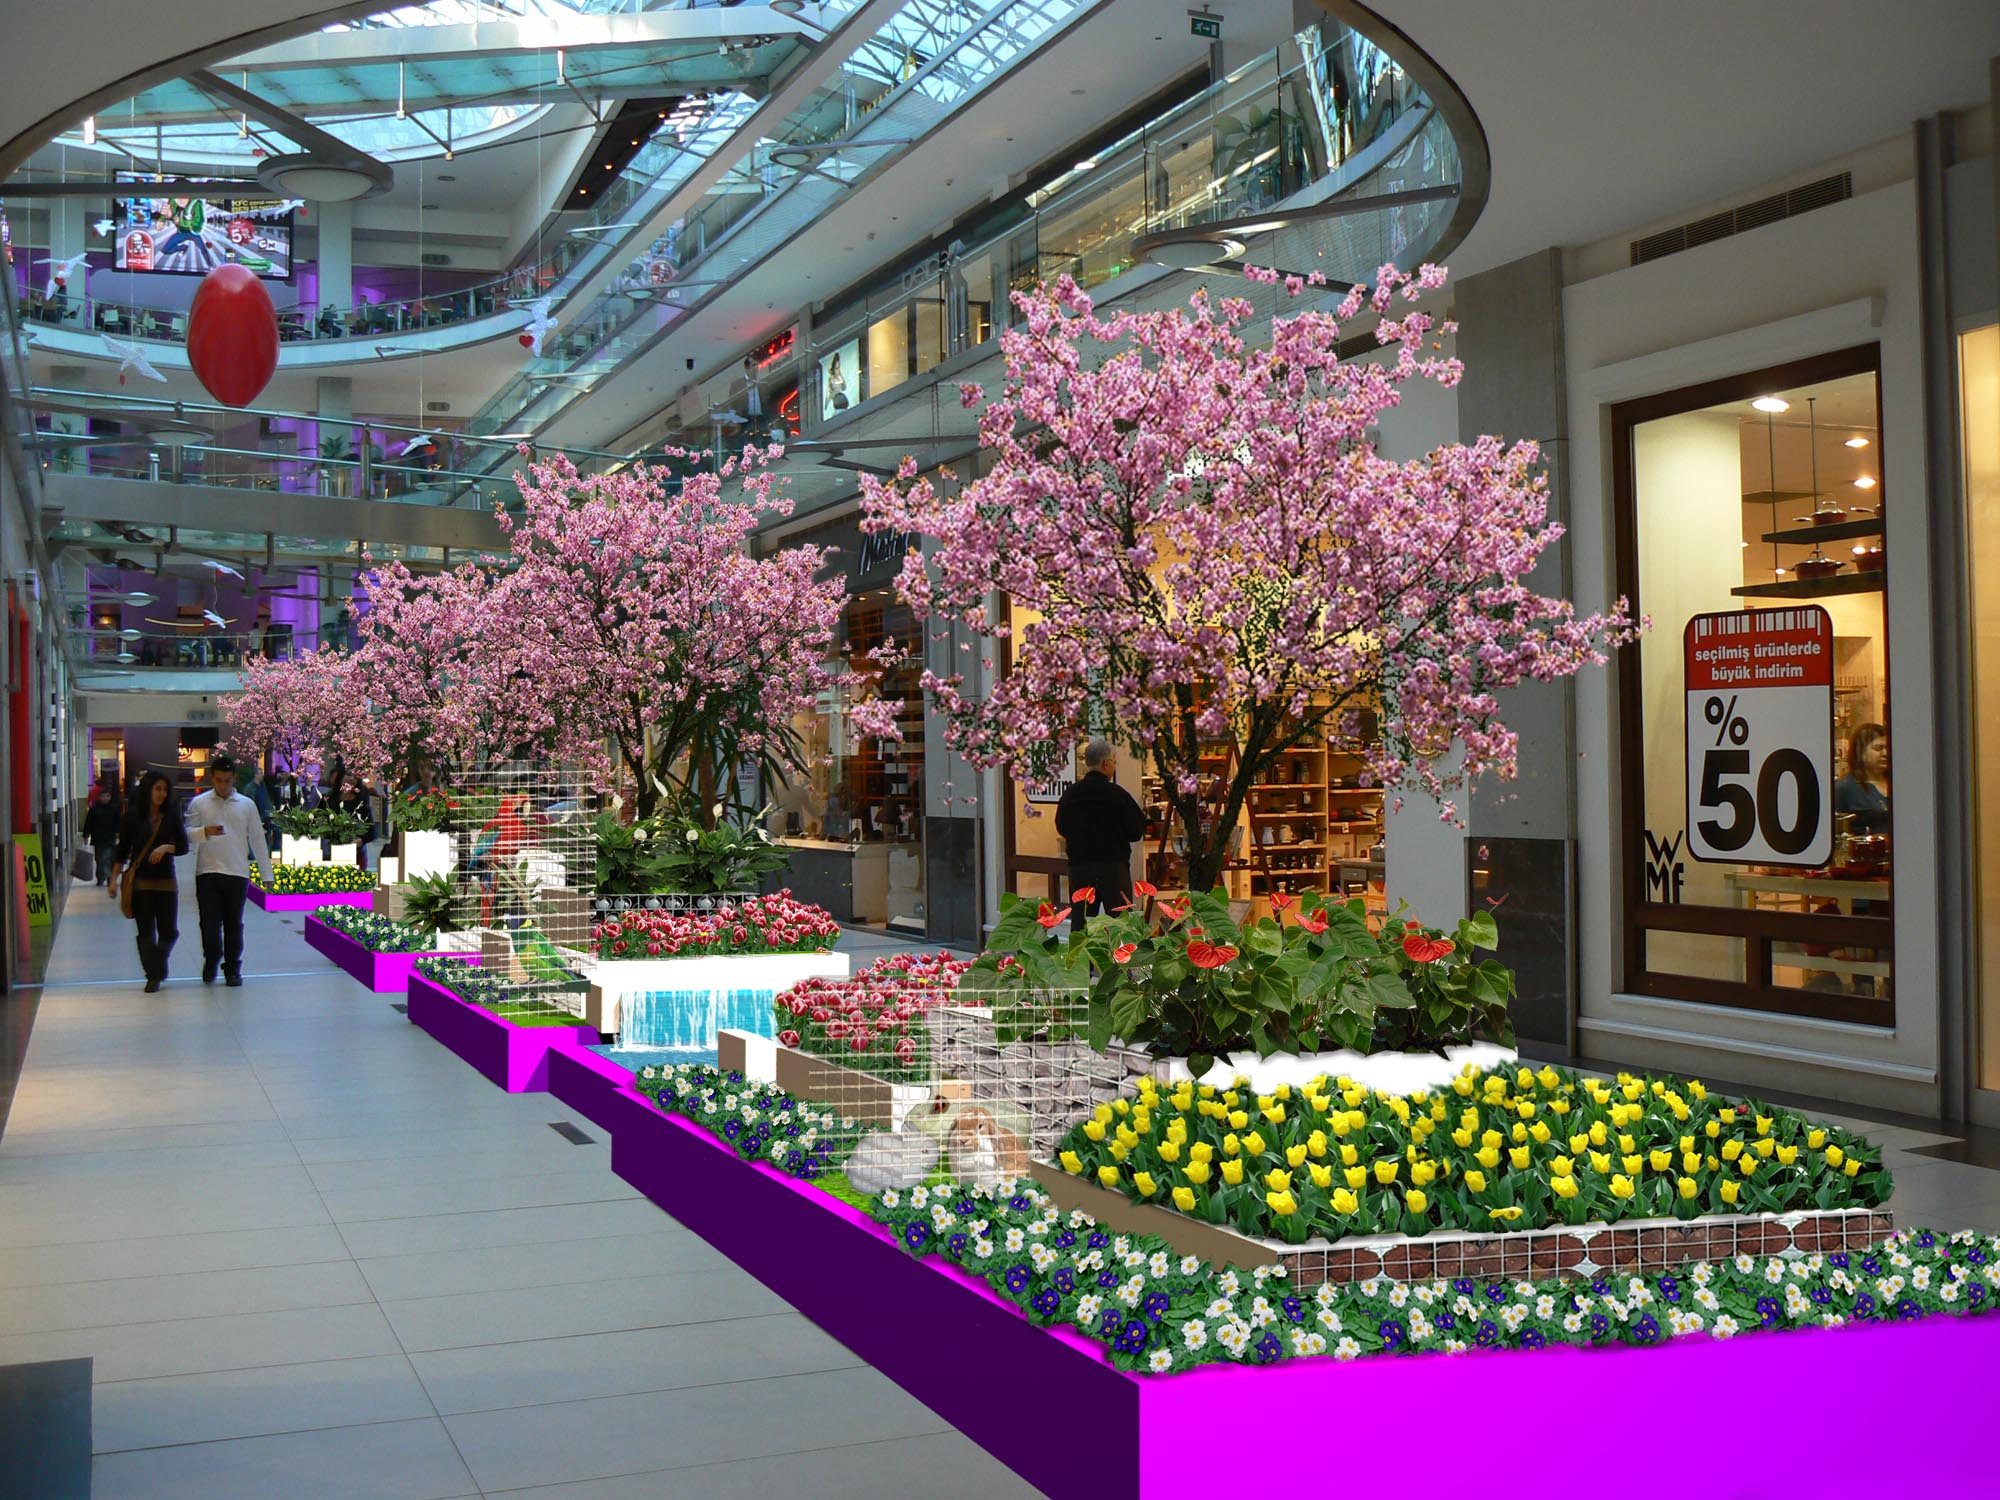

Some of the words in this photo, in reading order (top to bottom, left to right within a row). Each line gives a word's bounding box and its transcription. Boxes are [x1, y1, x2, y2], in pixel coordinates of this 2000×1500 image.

[1695, 645, 1750, 663] seçilmiş
[1754, 641, 1821, 658] ürünlerde
[1711, 666, 1751, 683] büyük
[1755, 663, 1803, 679] indirim
[1705, 695, 1749, 746] %
[1697, 748, 1821, 855] 50
